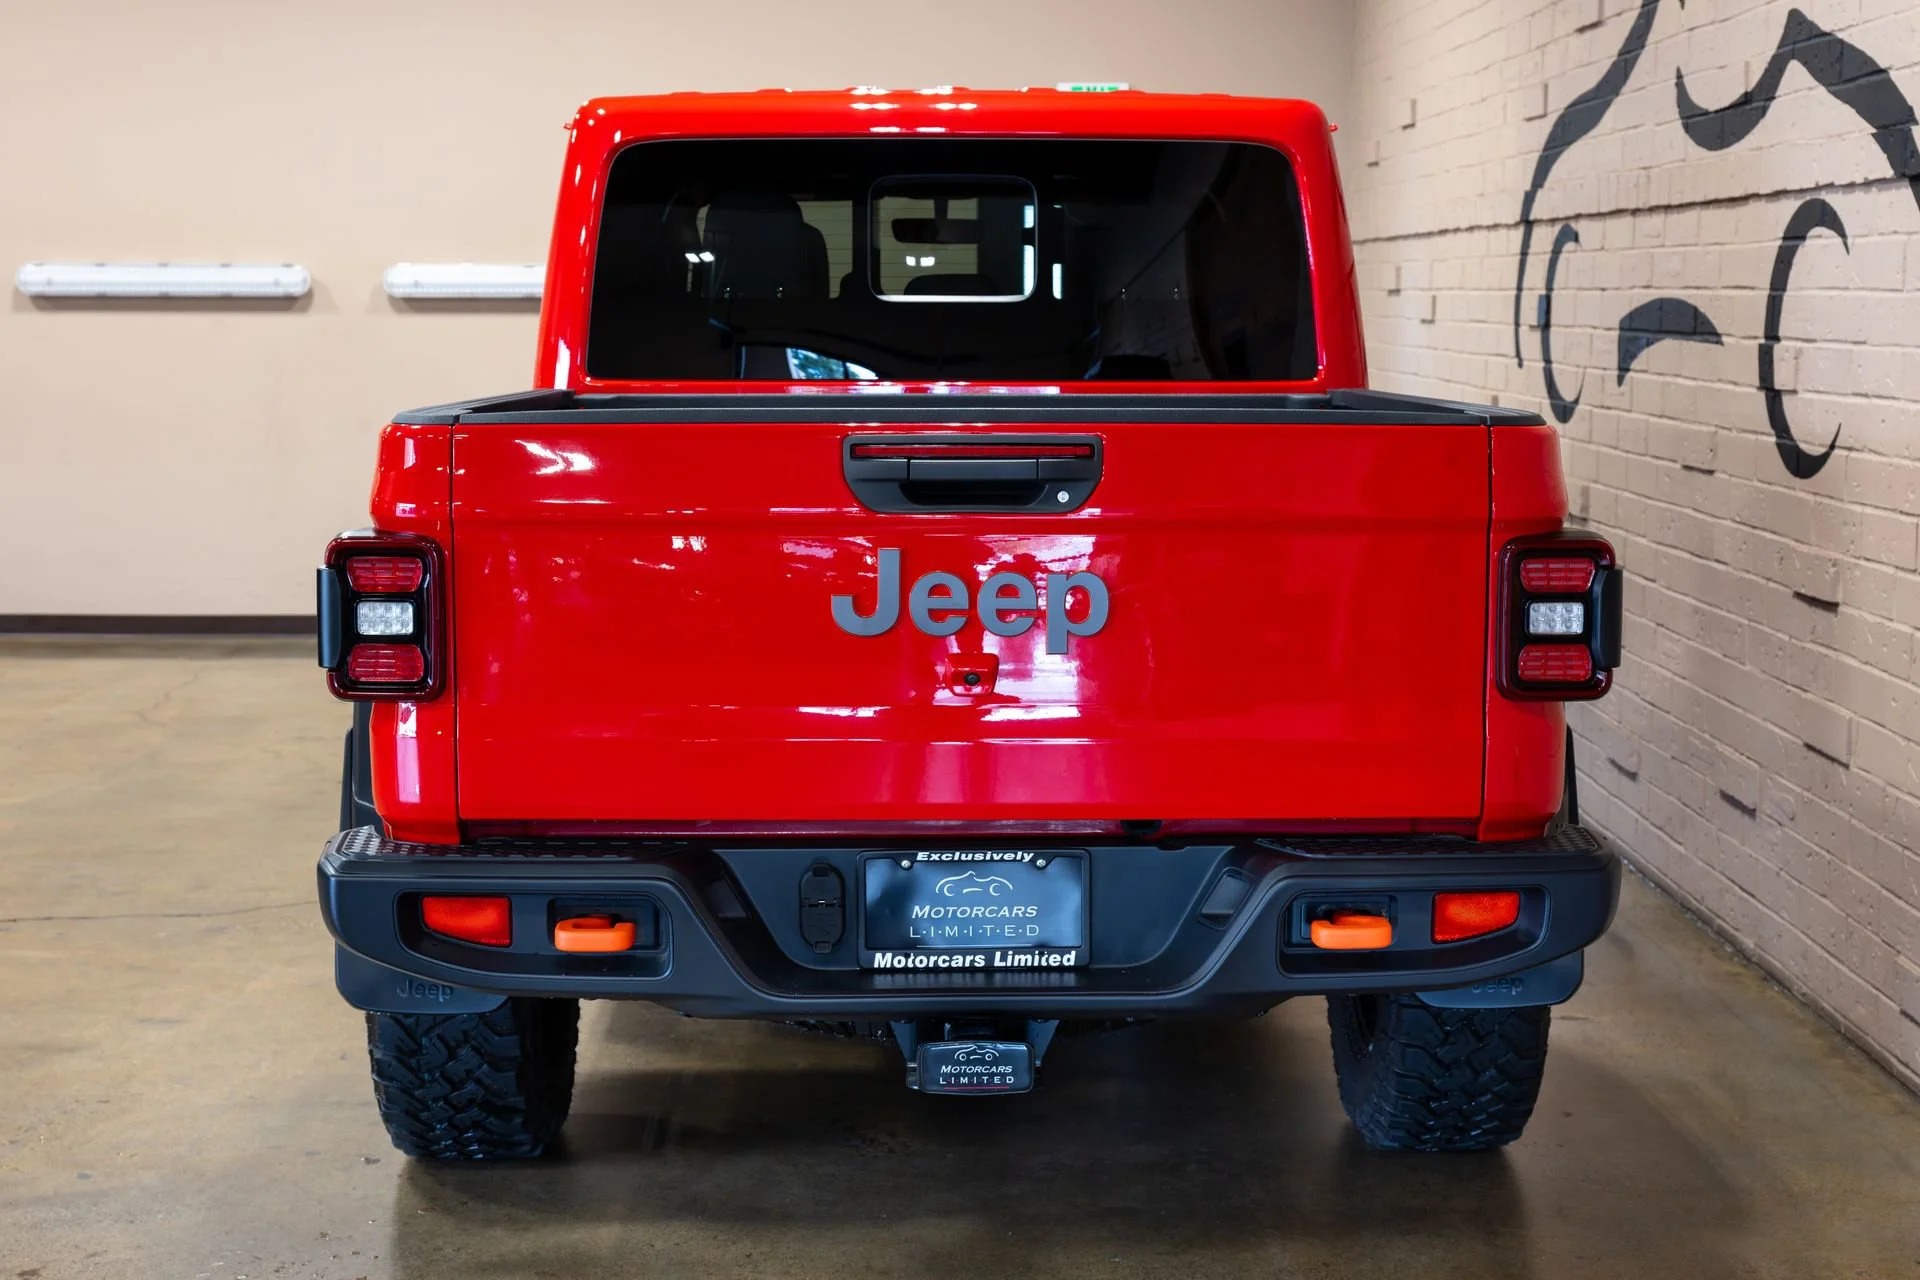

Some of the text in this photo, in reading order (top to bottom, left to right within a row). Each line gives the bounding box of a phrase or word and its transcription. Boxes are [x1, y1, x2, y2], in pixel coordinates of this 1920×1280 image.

[831, 547, 1109, 654] Jeep
[916, 851, 1034, 863] Exclusively
[911, 905, 1038, 919] MOTORCARS
[874, 951, 1076, 968] Motorcars Limited
[396, 979, 453, 1002] Jeep
